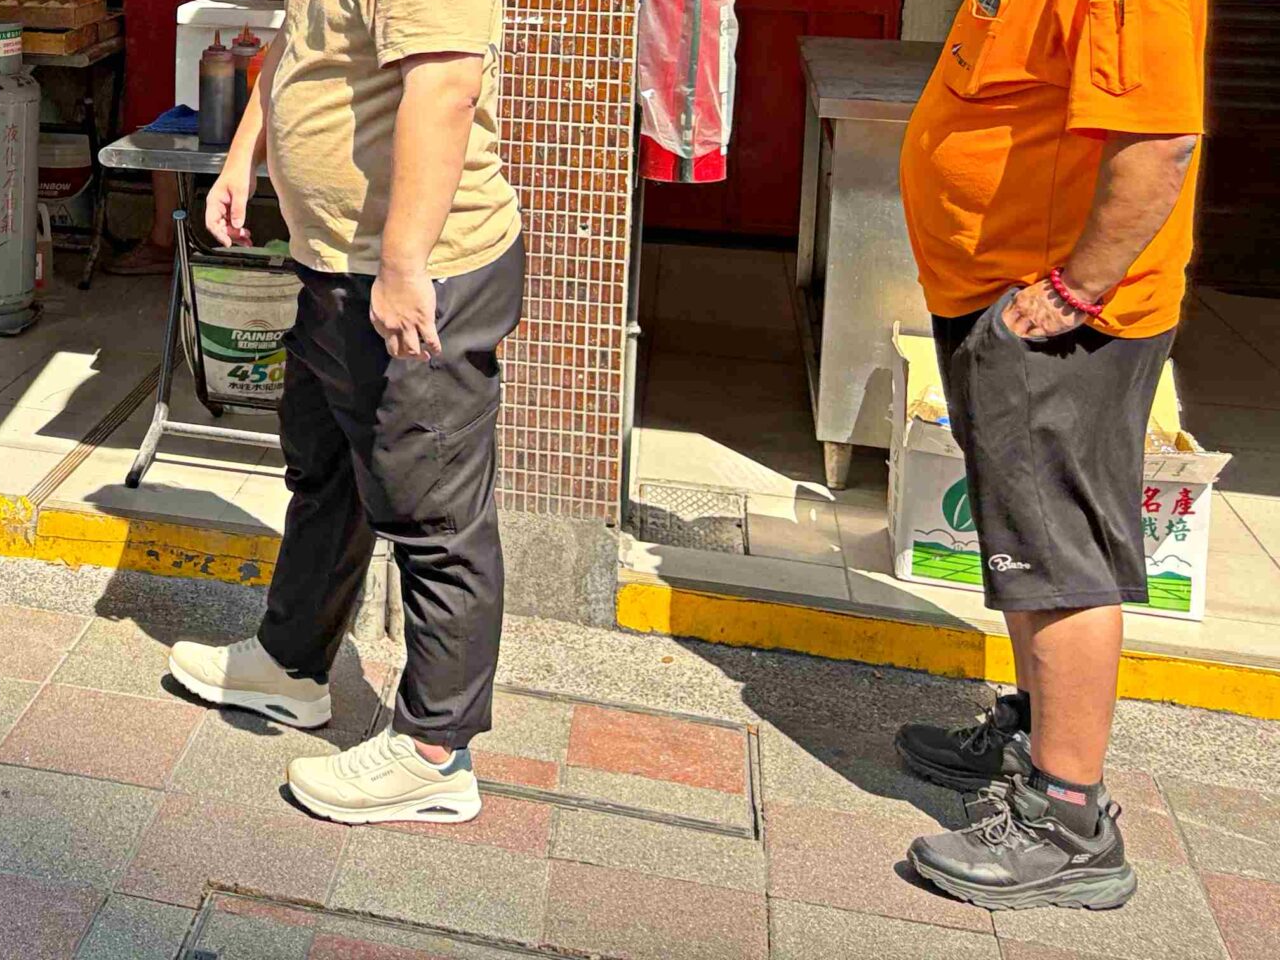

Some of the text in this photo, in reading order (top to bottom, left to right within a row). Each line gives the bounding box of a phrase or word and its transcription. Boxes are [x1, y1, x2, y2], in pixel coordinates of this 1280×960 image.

[39, 182, 72, 191] INBOW
[231, 329, 286, 341] RAINBO
[1141, 486, 1196, 516] 名產
